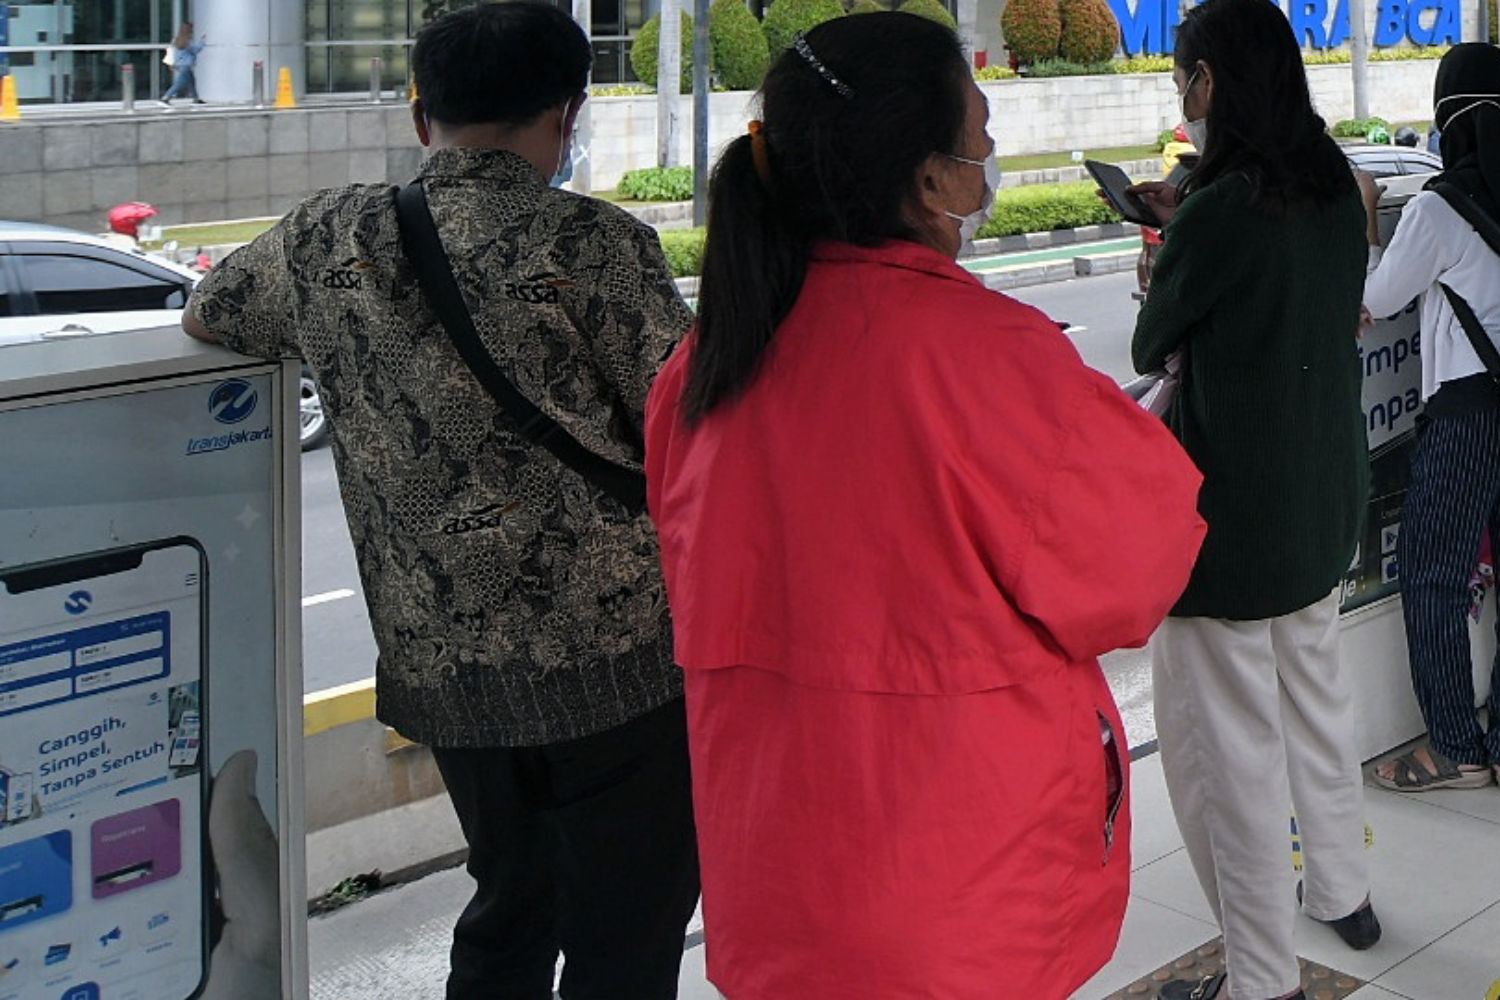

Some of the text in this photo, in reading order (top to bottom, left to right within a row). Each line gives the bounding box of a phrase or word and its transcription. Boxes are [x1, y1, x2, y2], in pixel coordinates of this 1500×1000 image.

[505, 283, 560, 304] assa
[186, 426, 272, 456] transjakart
[443, 515, 500, 535] assa
[38, 716, 127, 756] Canggih,
[39, 741, 111, 778] Simpel,
[40, 765, 97, 796] Tanpa
[101, 741, 165, 774] Sentuh
